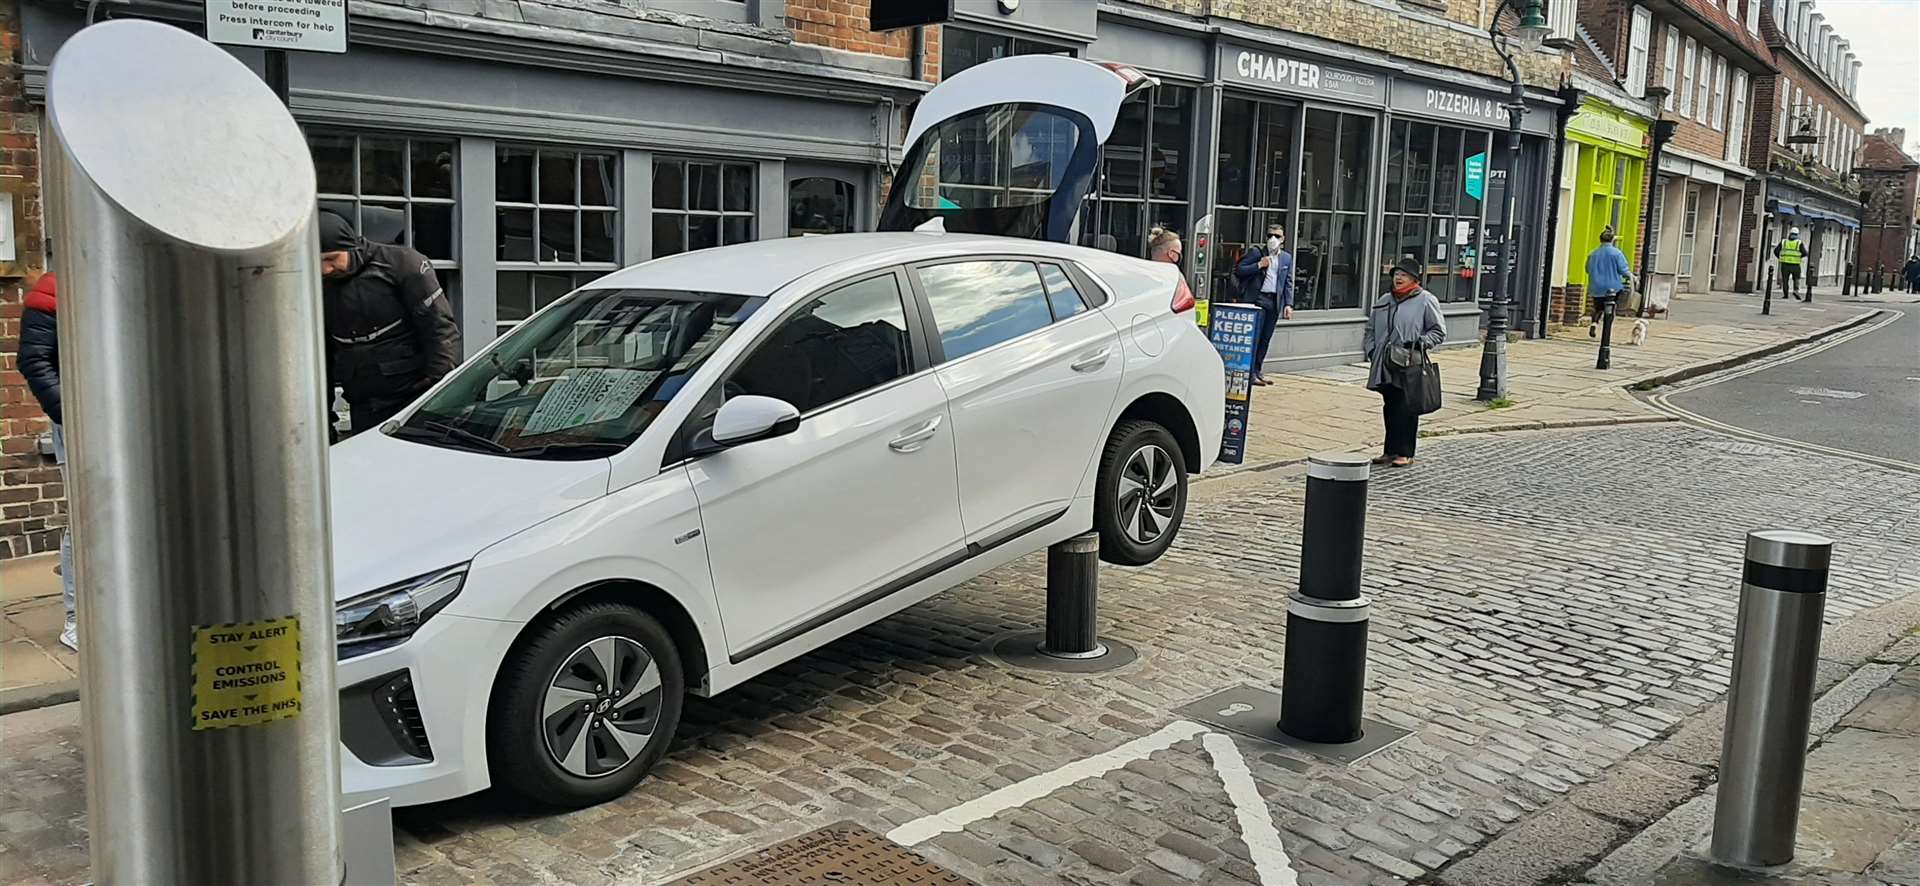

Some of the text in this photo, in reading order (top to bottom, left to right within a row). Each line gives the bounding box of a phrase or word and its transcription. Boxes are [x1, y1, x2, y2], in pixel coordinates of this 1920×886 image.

[232, 1, 321, 17] before proceeding
[219, 14, 247, 24] Press
[296, 20, 311, 29] for
[313, 23, 335, 32] help
[1237, 51, 1320, 89] CHAPTER
[1426, 89, 1510, 122] PIZZERIA & BA
[1215, 310, 1255, 322] PLEASE
[1214, 320, 1253, 334] KEEP
[1213, 333, 1252, 345] A SAFE
[209, 626, 288, 644] STAY ALERT
[215, 661, 281, 677] CONTROL
[213, 671, 286, 690] EMISSIONS
[201, 698, 296, 721] SAVE THE NHS
